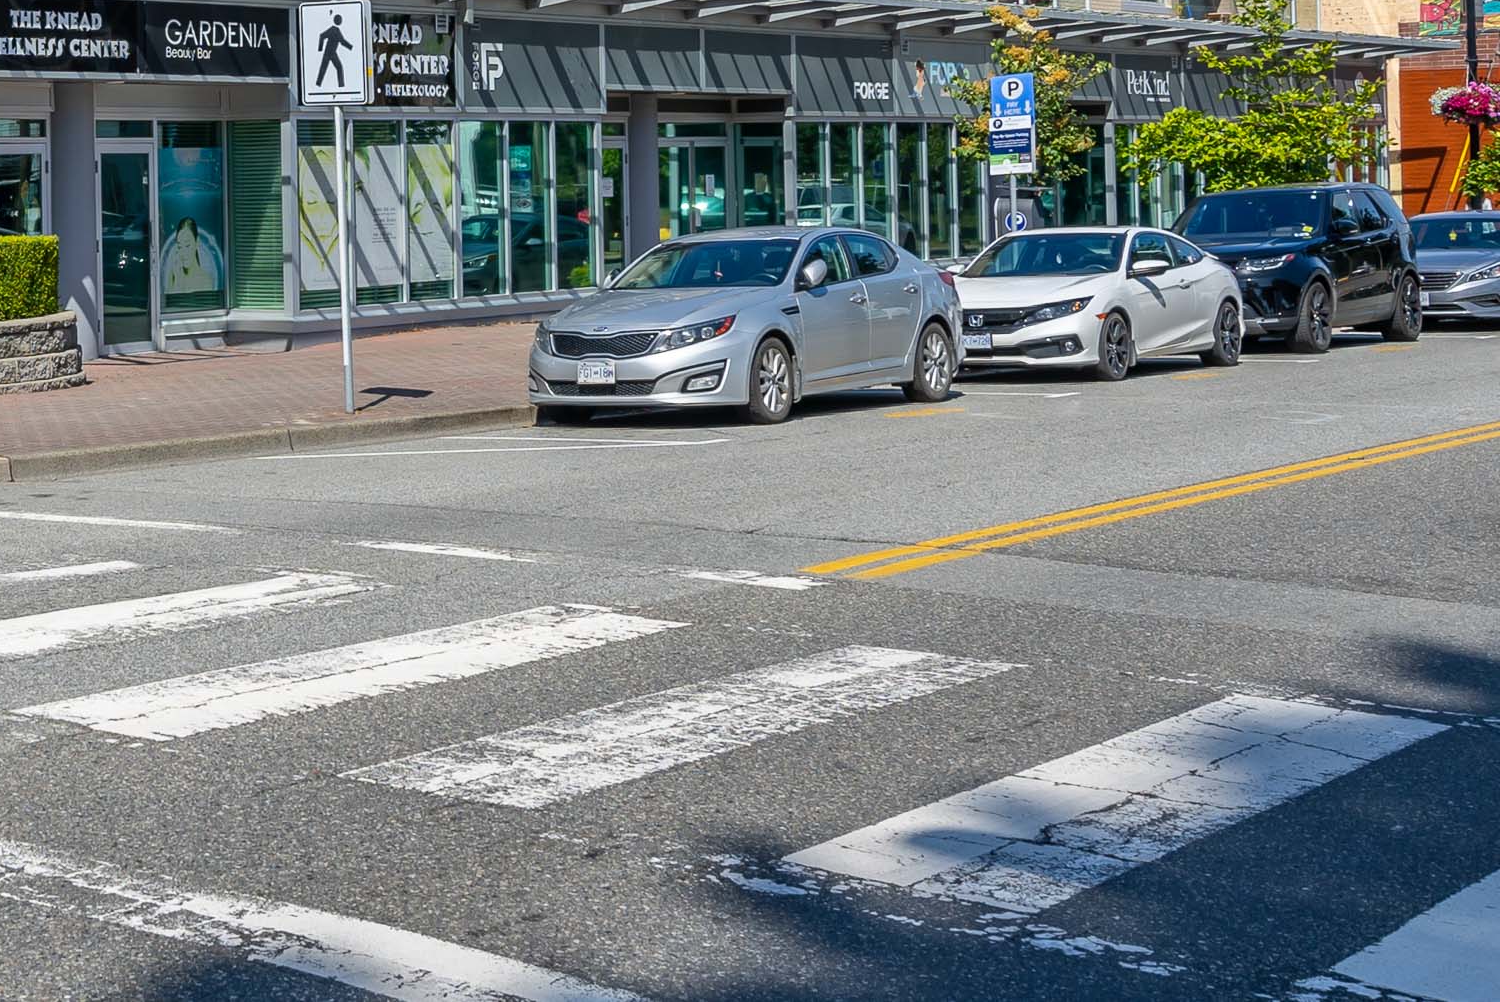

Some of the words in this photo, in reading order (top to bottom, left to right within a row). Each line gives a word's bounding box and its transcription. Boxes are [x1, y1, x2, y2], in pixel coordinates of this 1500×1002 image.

[10, 9, 42, 30] THE
[45, 10, 102, 31] KNEAD
[164, 19, 271, 48] GARDENIA
[69, 38, 130, 59] CENTER
[165, 46, 196, 61] Beauty
[197, 48, 212, 59] Bar
[390, 53, 449, 75] CENTER
[385, 84, 449, 97] REFLEXOLOGY
[853, 82, 889, 99] FORGE
[1008, 81, 1019, 97] P
